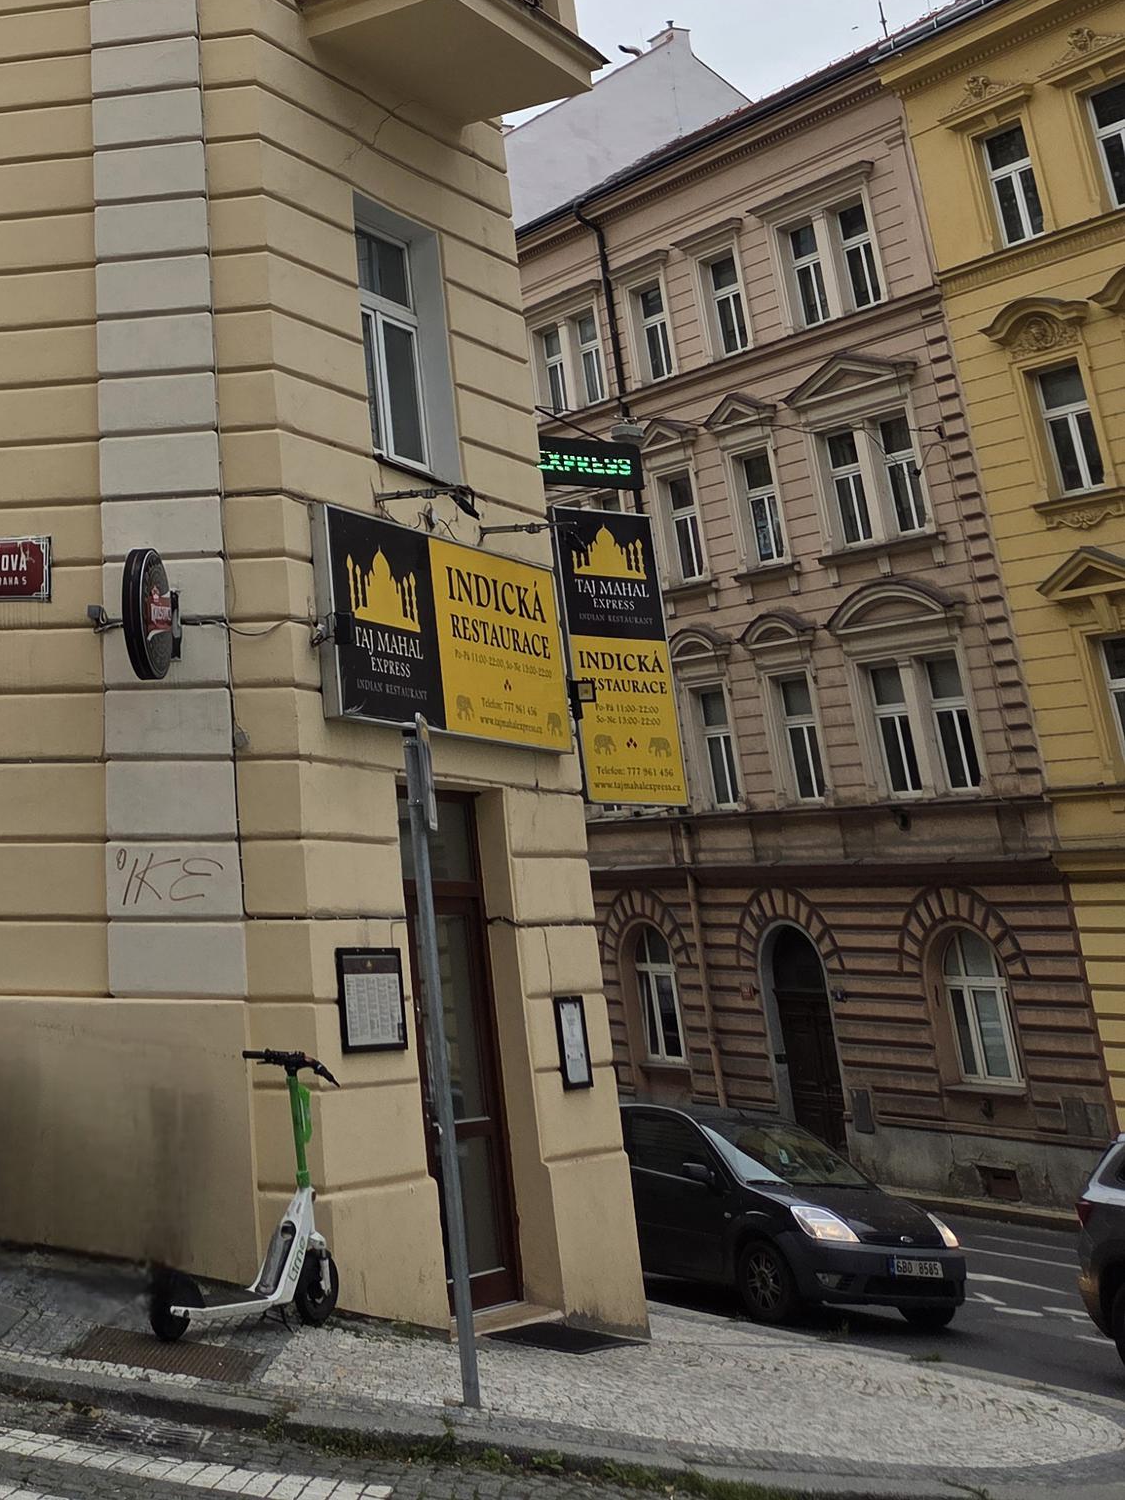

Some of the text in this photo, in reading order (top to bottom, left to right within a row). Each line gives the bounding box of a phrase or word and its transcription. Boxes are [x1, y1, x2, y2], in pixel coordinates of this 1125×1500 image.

[445, 566, 547, 624] INDICKÁ
[574, 578, 650, 598] TAJ MAHAL
[593, 598, 635, 611] EXPRESS
[579, 612, 654, 626] INDIAN RESTAURANT
[354, 626, 424, 660] TAJ MAHAL
[450, 613, 551, 660] RESTAURACE
[371, 657, 411, 678] EXPRESS
[578, 650, 665, 674] INDICKÁ
[356, 678, 428, 701] INDIAN RESTAURANT
[596, 766, 674, 777] Telefon: 777 961 456
[594, 781, 682, 792] www.tajmahalexpress.cz
[288, 1235, 306, 1282] Lime
